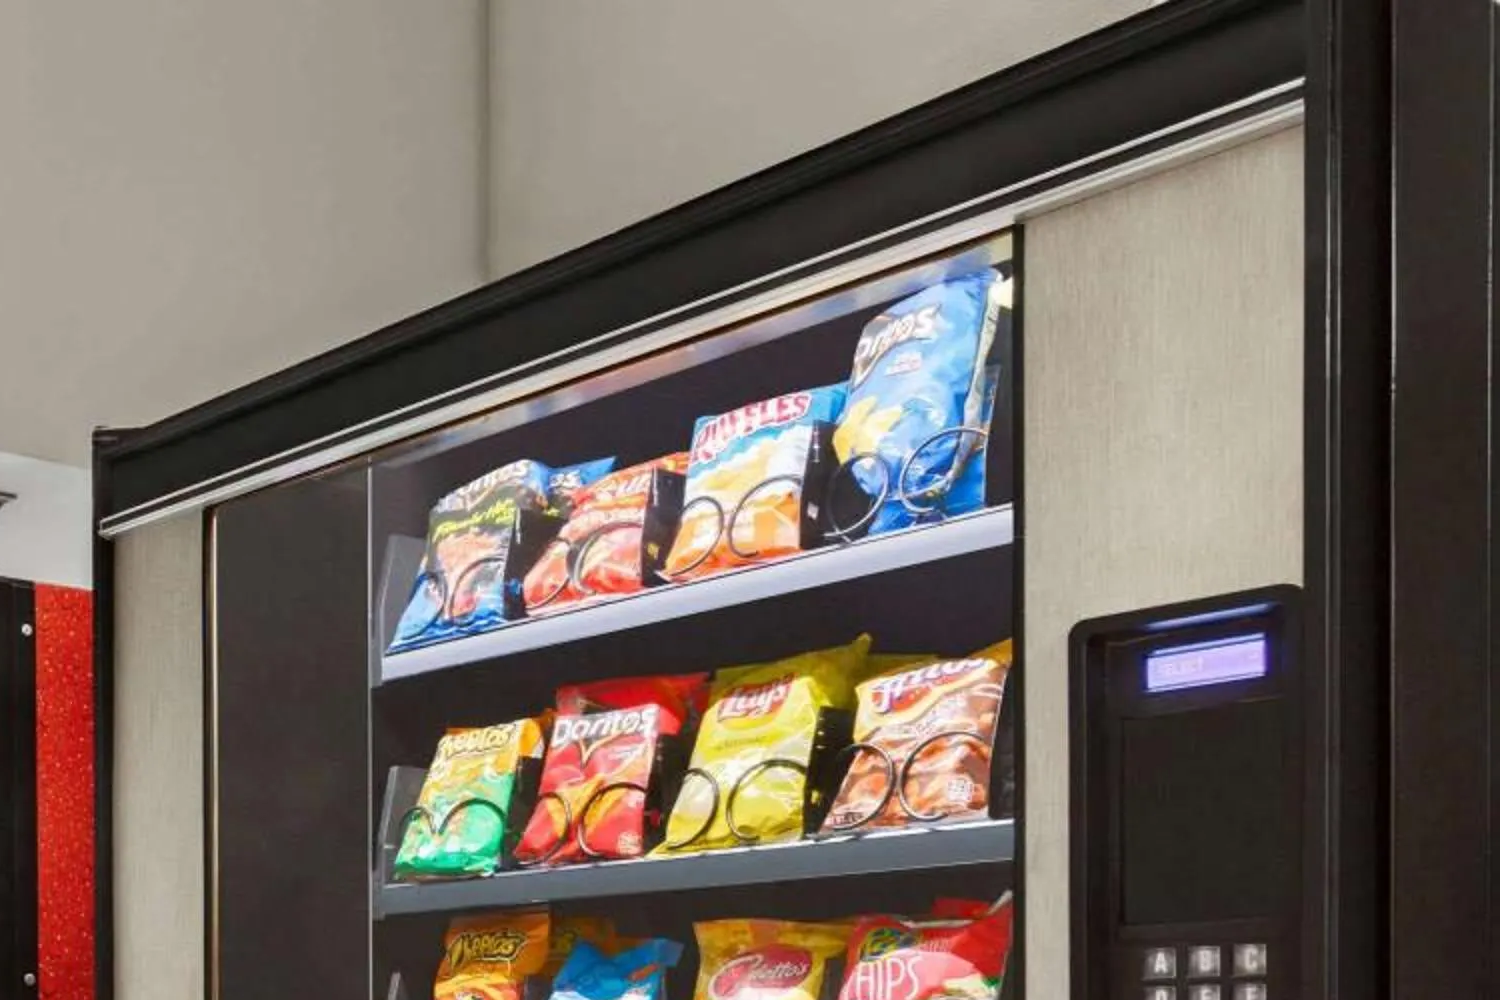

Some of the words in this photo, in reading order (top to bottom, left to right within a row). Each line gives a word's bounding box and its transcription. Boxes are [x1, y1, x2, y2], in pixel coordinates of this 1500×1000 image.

[551, 708, 658, 748] Doritos
[1154, 952, 1168, 974] A
[1199, 949, 1212, 972] B
[1245, 947, 1258, 971] C
